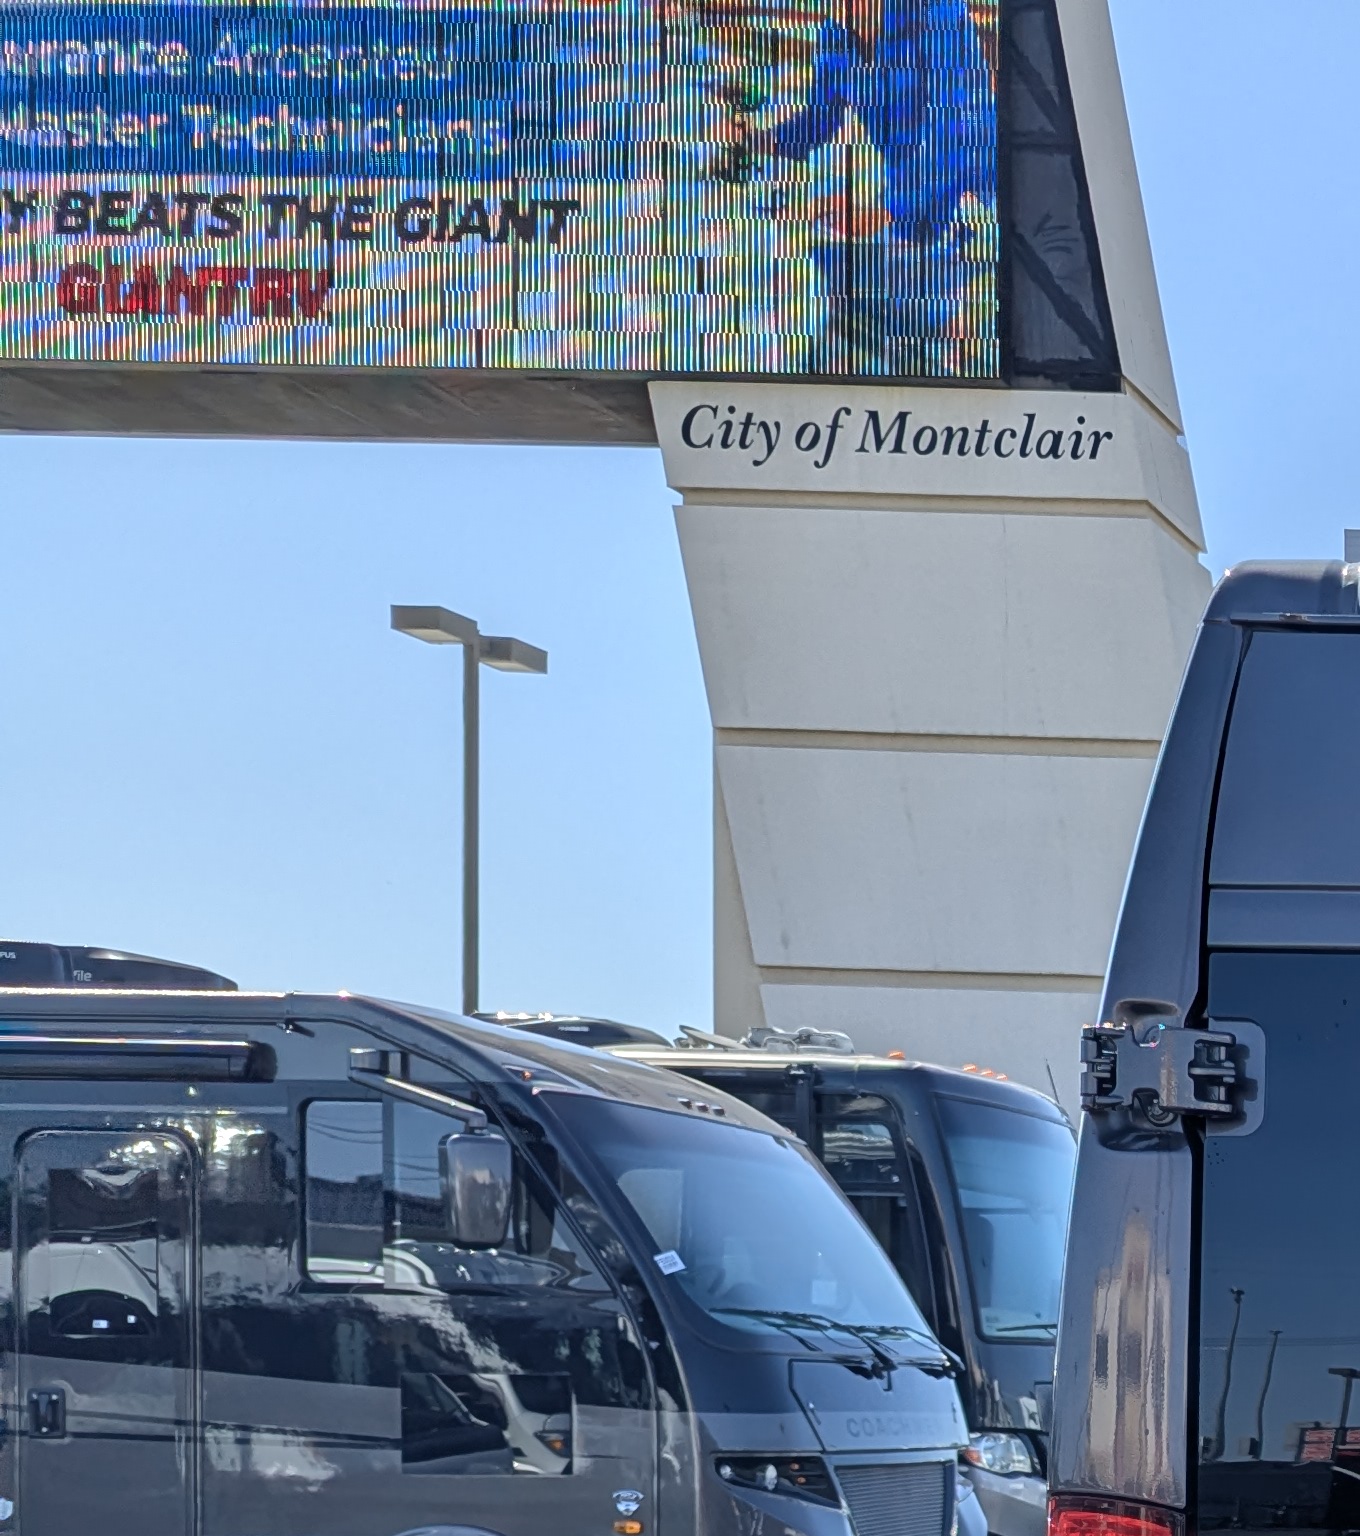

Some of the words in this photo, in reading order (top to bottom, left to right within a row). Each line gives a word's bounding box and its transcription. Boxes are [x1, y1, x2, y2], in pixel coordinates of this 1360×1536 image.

[182, 105, 508, 155] Technicians
[56, 190, 243, 238] BEATS
[262, 193, 376, 241] THE
[398, 197, 582, 244] GIANT
[681, 404, 781, 467] City
[794, 406, 852, 469] of
[855, 409, 1114, 461] Montclair
